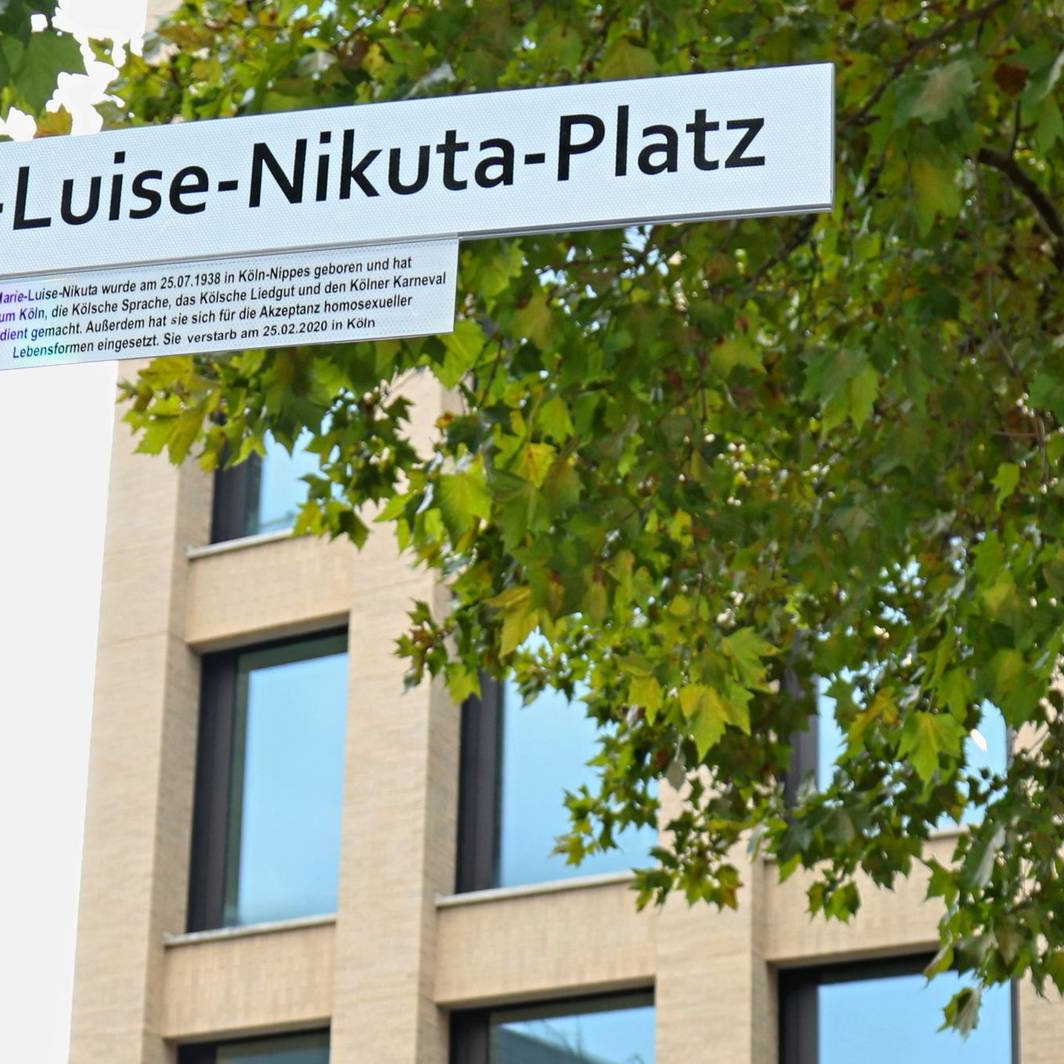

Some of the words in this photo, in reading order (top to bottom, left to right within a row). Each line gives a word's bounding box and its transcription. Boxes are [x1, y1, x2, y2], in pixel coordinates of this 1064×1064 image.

[19, 308, 47, 320] Köln,
[51, 304, 68, 318] die
[72, 300, 118, 316] Kölsche
[122, 296, 171, 314] Sprache,
[176, 294, 196, 307] das
[200, 289, 246, 304] Kölsche
[250, 285, 295, 301] Liedgut
[298, 281, 321, 296] und
[324, 281, 346, 294] den
[350, 278, 390, 292] Kölner
[393, 271, 446, 288] Karneval
[101, 280, 136, 294] wurde
[140, 281, 156, 291] am
[160, 272, 220, 289] 25.07.1938
[224, 272, 235, 283] in
[239, 266, 310, 282] Köln-Nippes
[314, 262, 362, 279] geboren
[367, 258, 389, 271] und
[393, 257, 412, 269] hat
[13, 341, 94, 359] Lebensformen
[97, 335, 159, 352] eingesetzt.
[163, 332, 181, 346] Sie
[187, 329, 236, 343] verstarb
[241, 329, 259, 339] am
[263, 320, 327, 337] 25.02.2020
[332, 319, 343, 330] in
[347, 317, 376, 329] Köln
[31, 322, 82, 341] gemacht.
[86, 318, 144, 333] Außerdem
[148, 315, 167, 327] hat
[171, 312, 188, 325] sie
[191, 309, 215, 323] sich
[219, 309, 236, 321] für
[239, 306, 256, 320] die
[259, 303, 320, 319] Akzeptanz
[324, 294, 413, 312] homosexueller
